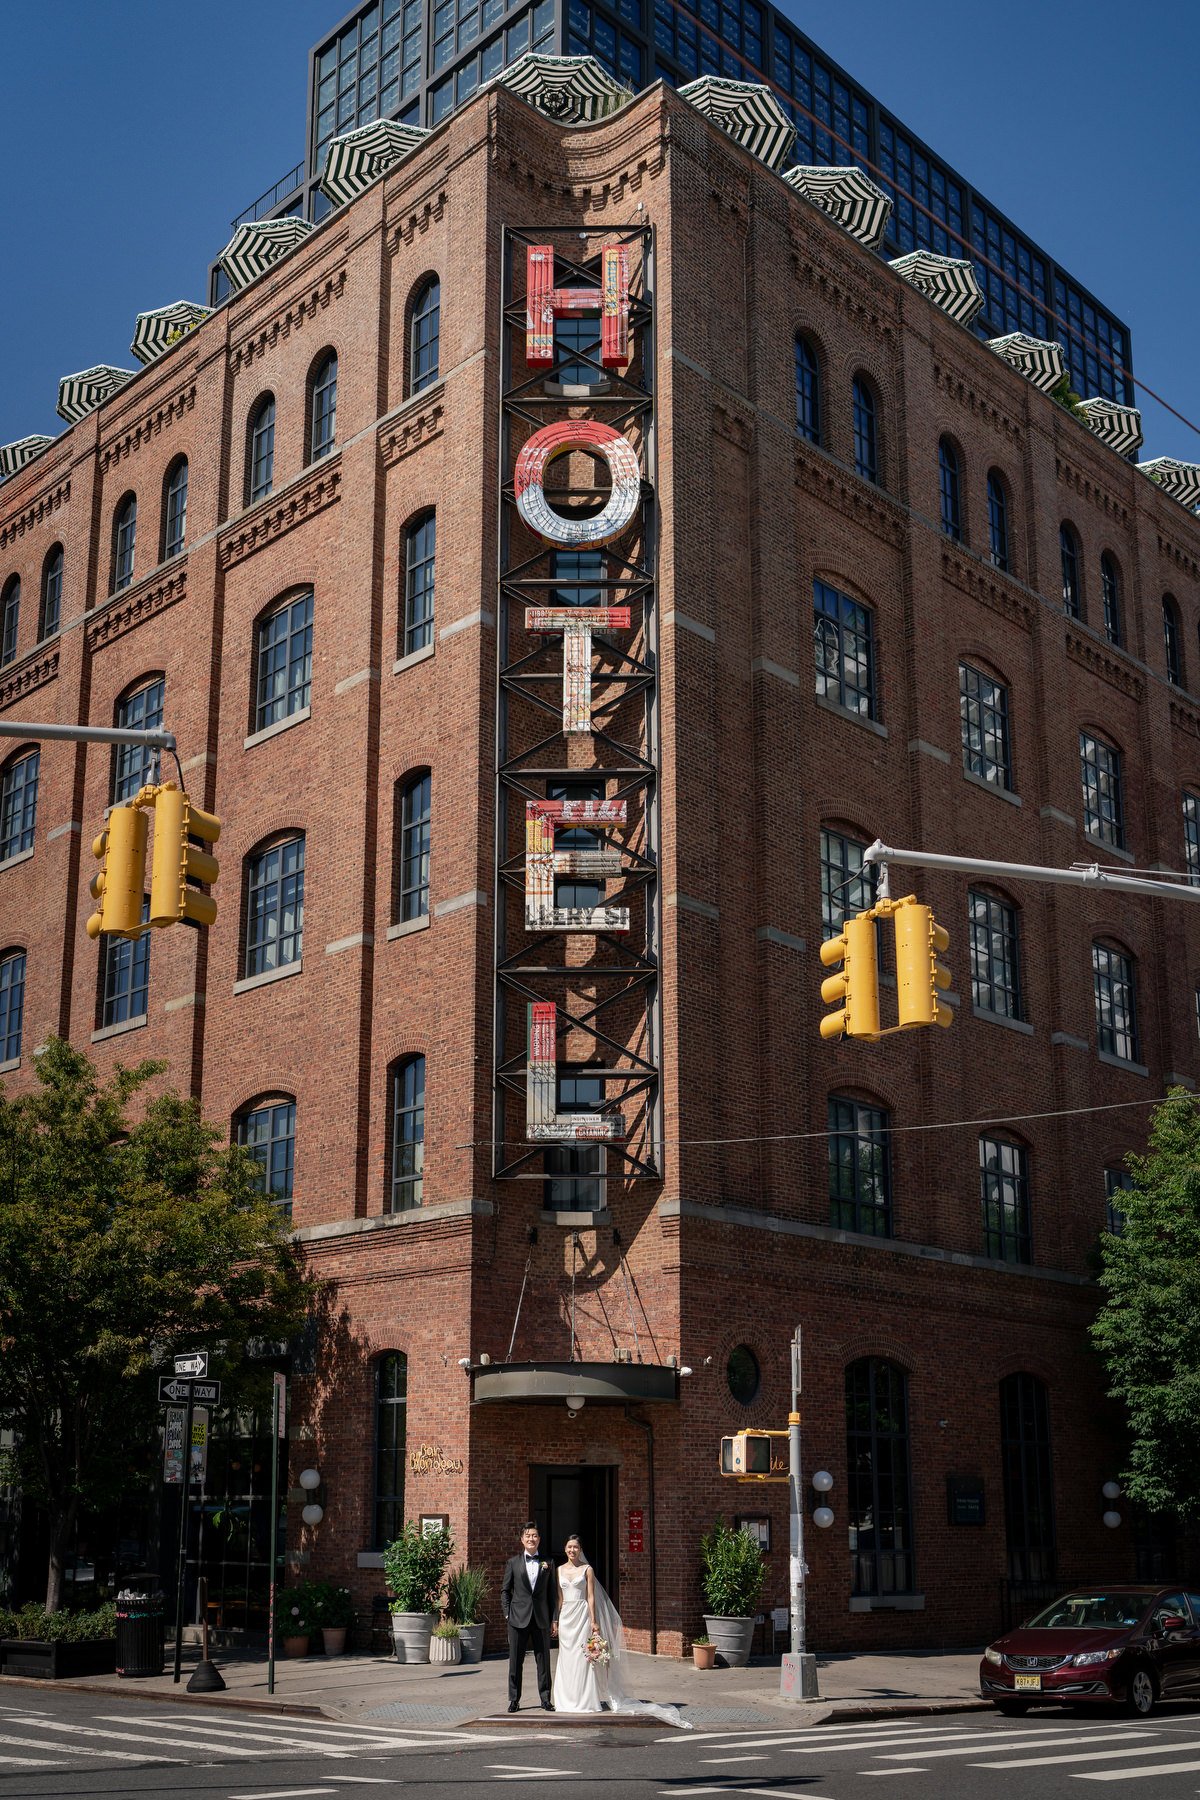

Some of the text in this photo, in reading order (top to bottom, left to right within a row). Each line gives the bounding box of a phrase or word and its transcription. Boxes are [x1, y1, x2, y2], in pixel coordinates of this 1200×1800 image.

[515, 245, 640, 1141] HOTEL
[175, 1360, 202, 1372] ONE WAY
[169, 1385, 212, 1397] ONE WAY
[421, 1443, 441, 1458] Bar
